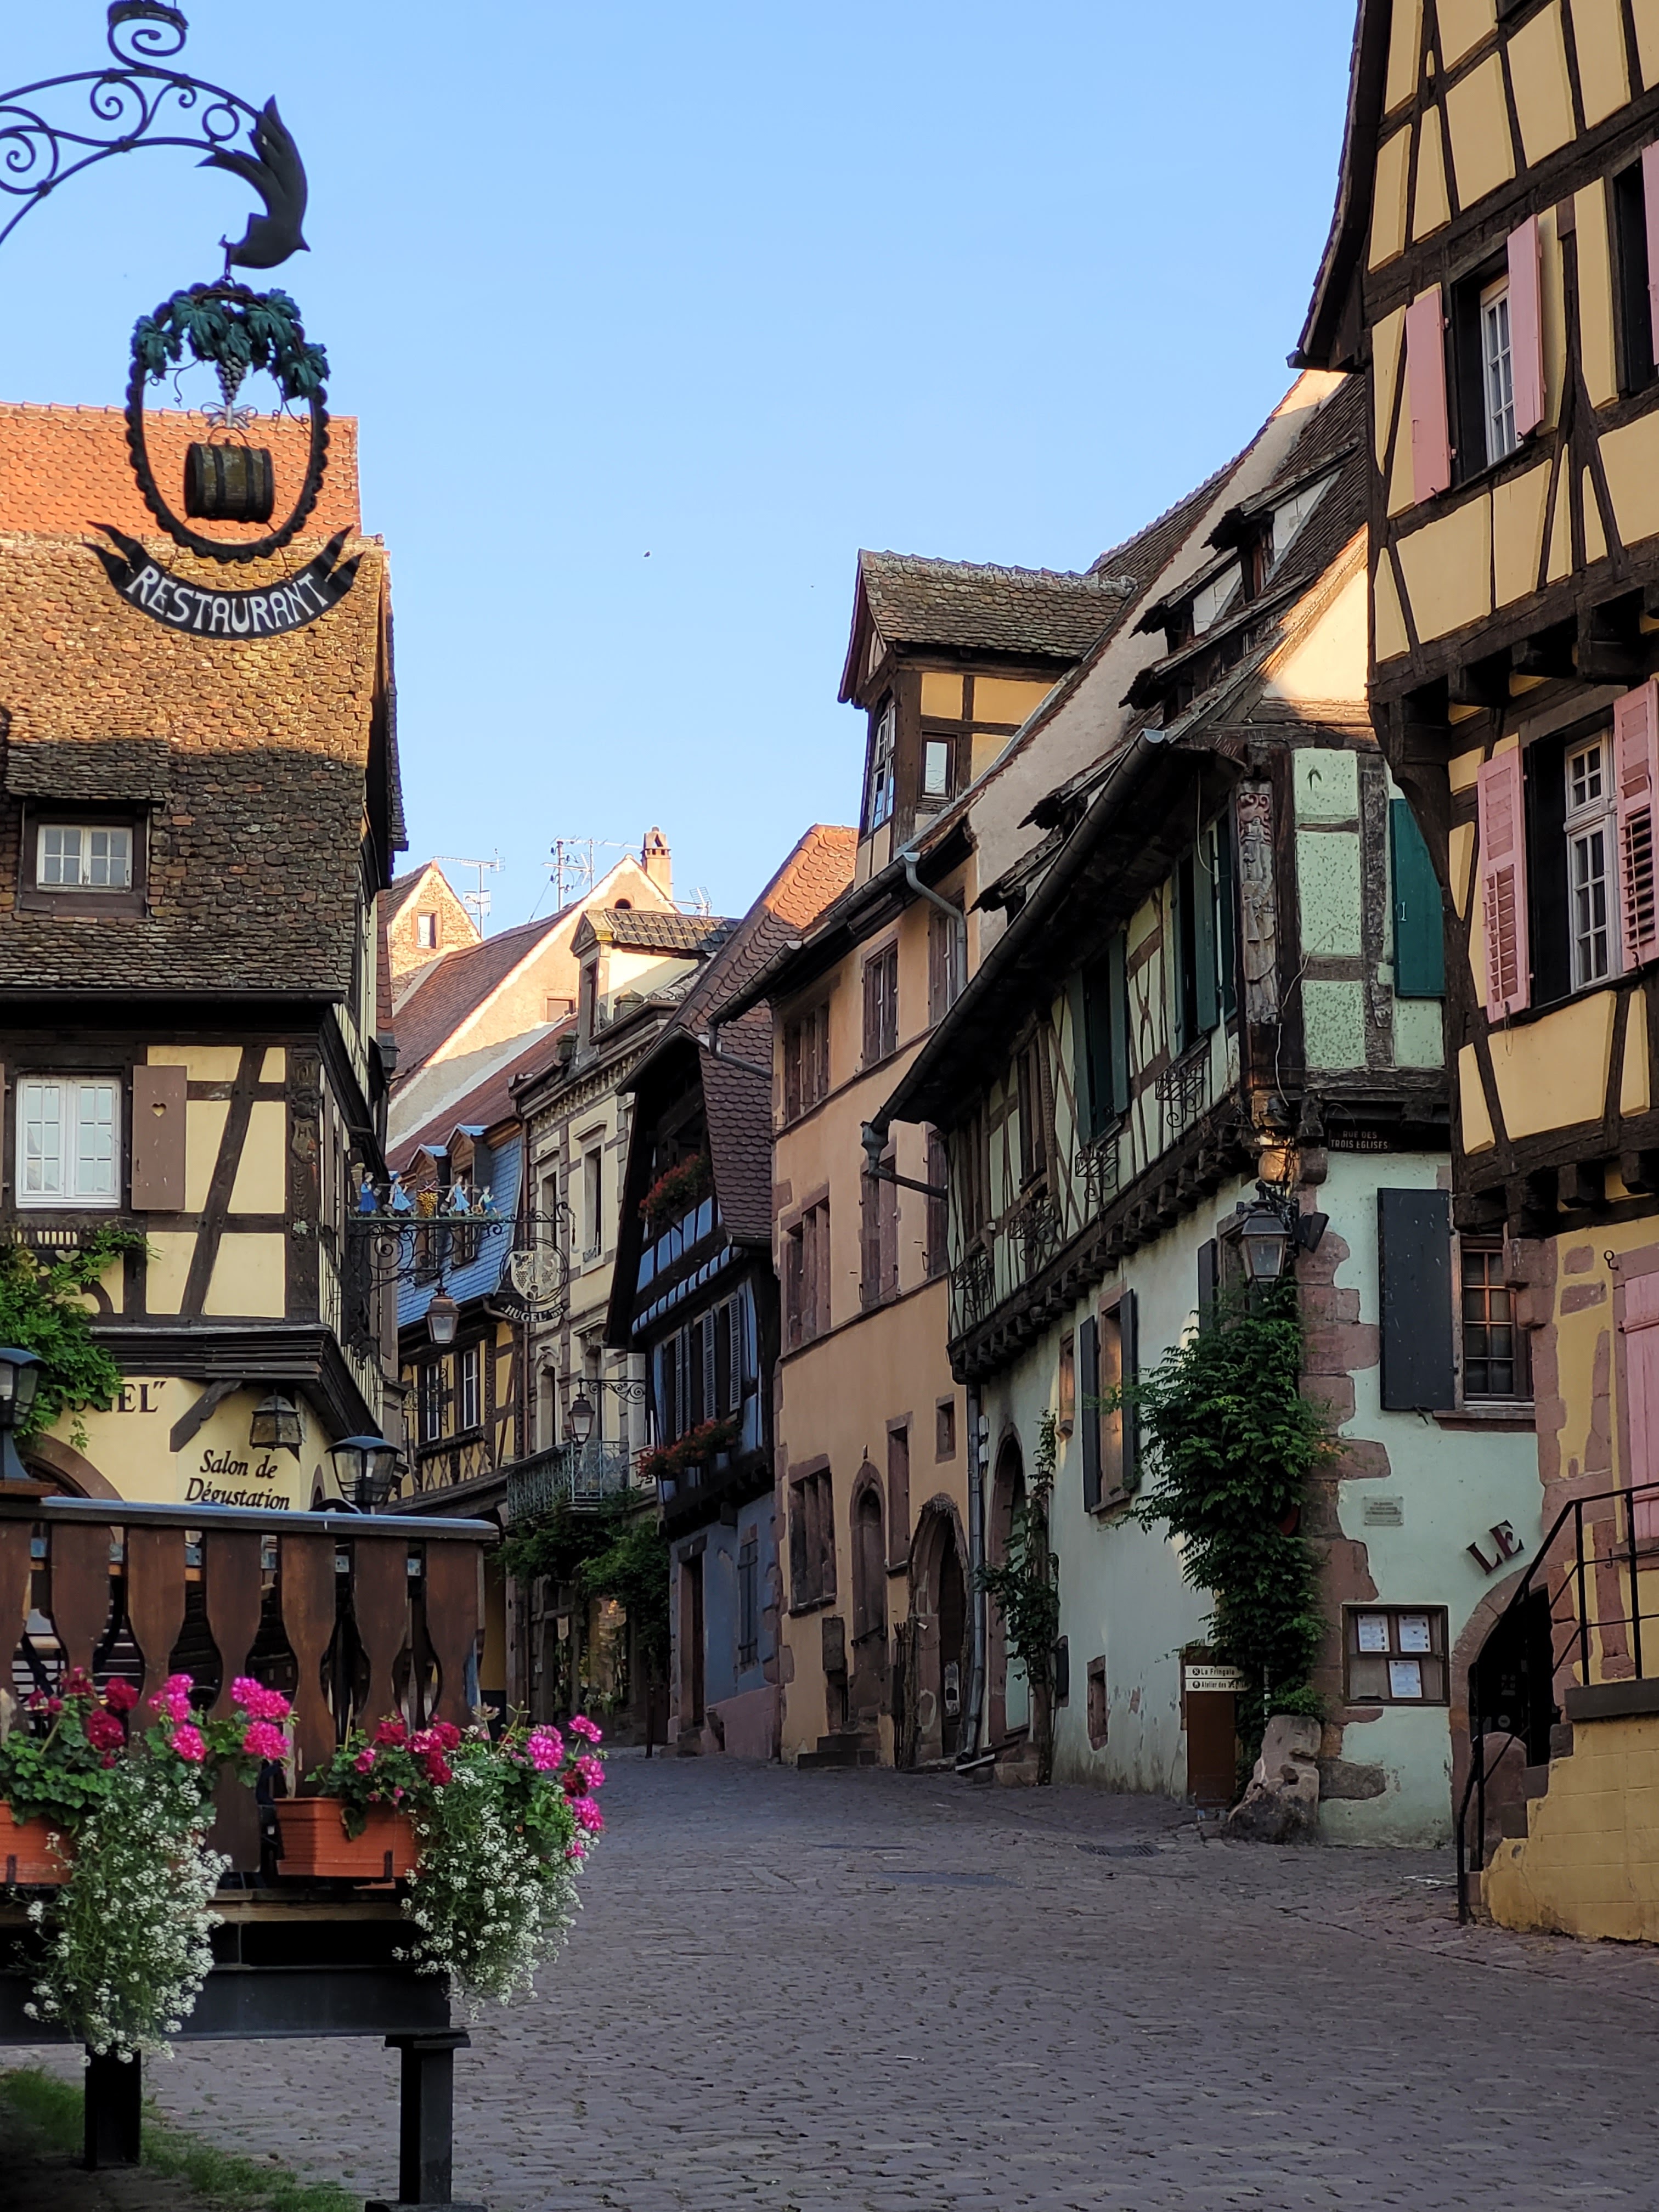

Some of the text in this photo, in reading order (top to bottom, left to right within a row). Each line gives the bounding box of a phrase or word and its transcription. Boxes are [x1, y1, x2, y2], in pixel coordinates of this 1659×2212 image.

[126, 565, 329, 633] RESTAURANT
[1331, 1139, 1353, 1148] TROIS
[199, 1449, 278, 1479] Salon de
[184, 1477, 290, 1510] Dégustation
[1466, 1519, 1525, 1576] LE
[1210, 1668, 1235, 1677] Fringale
